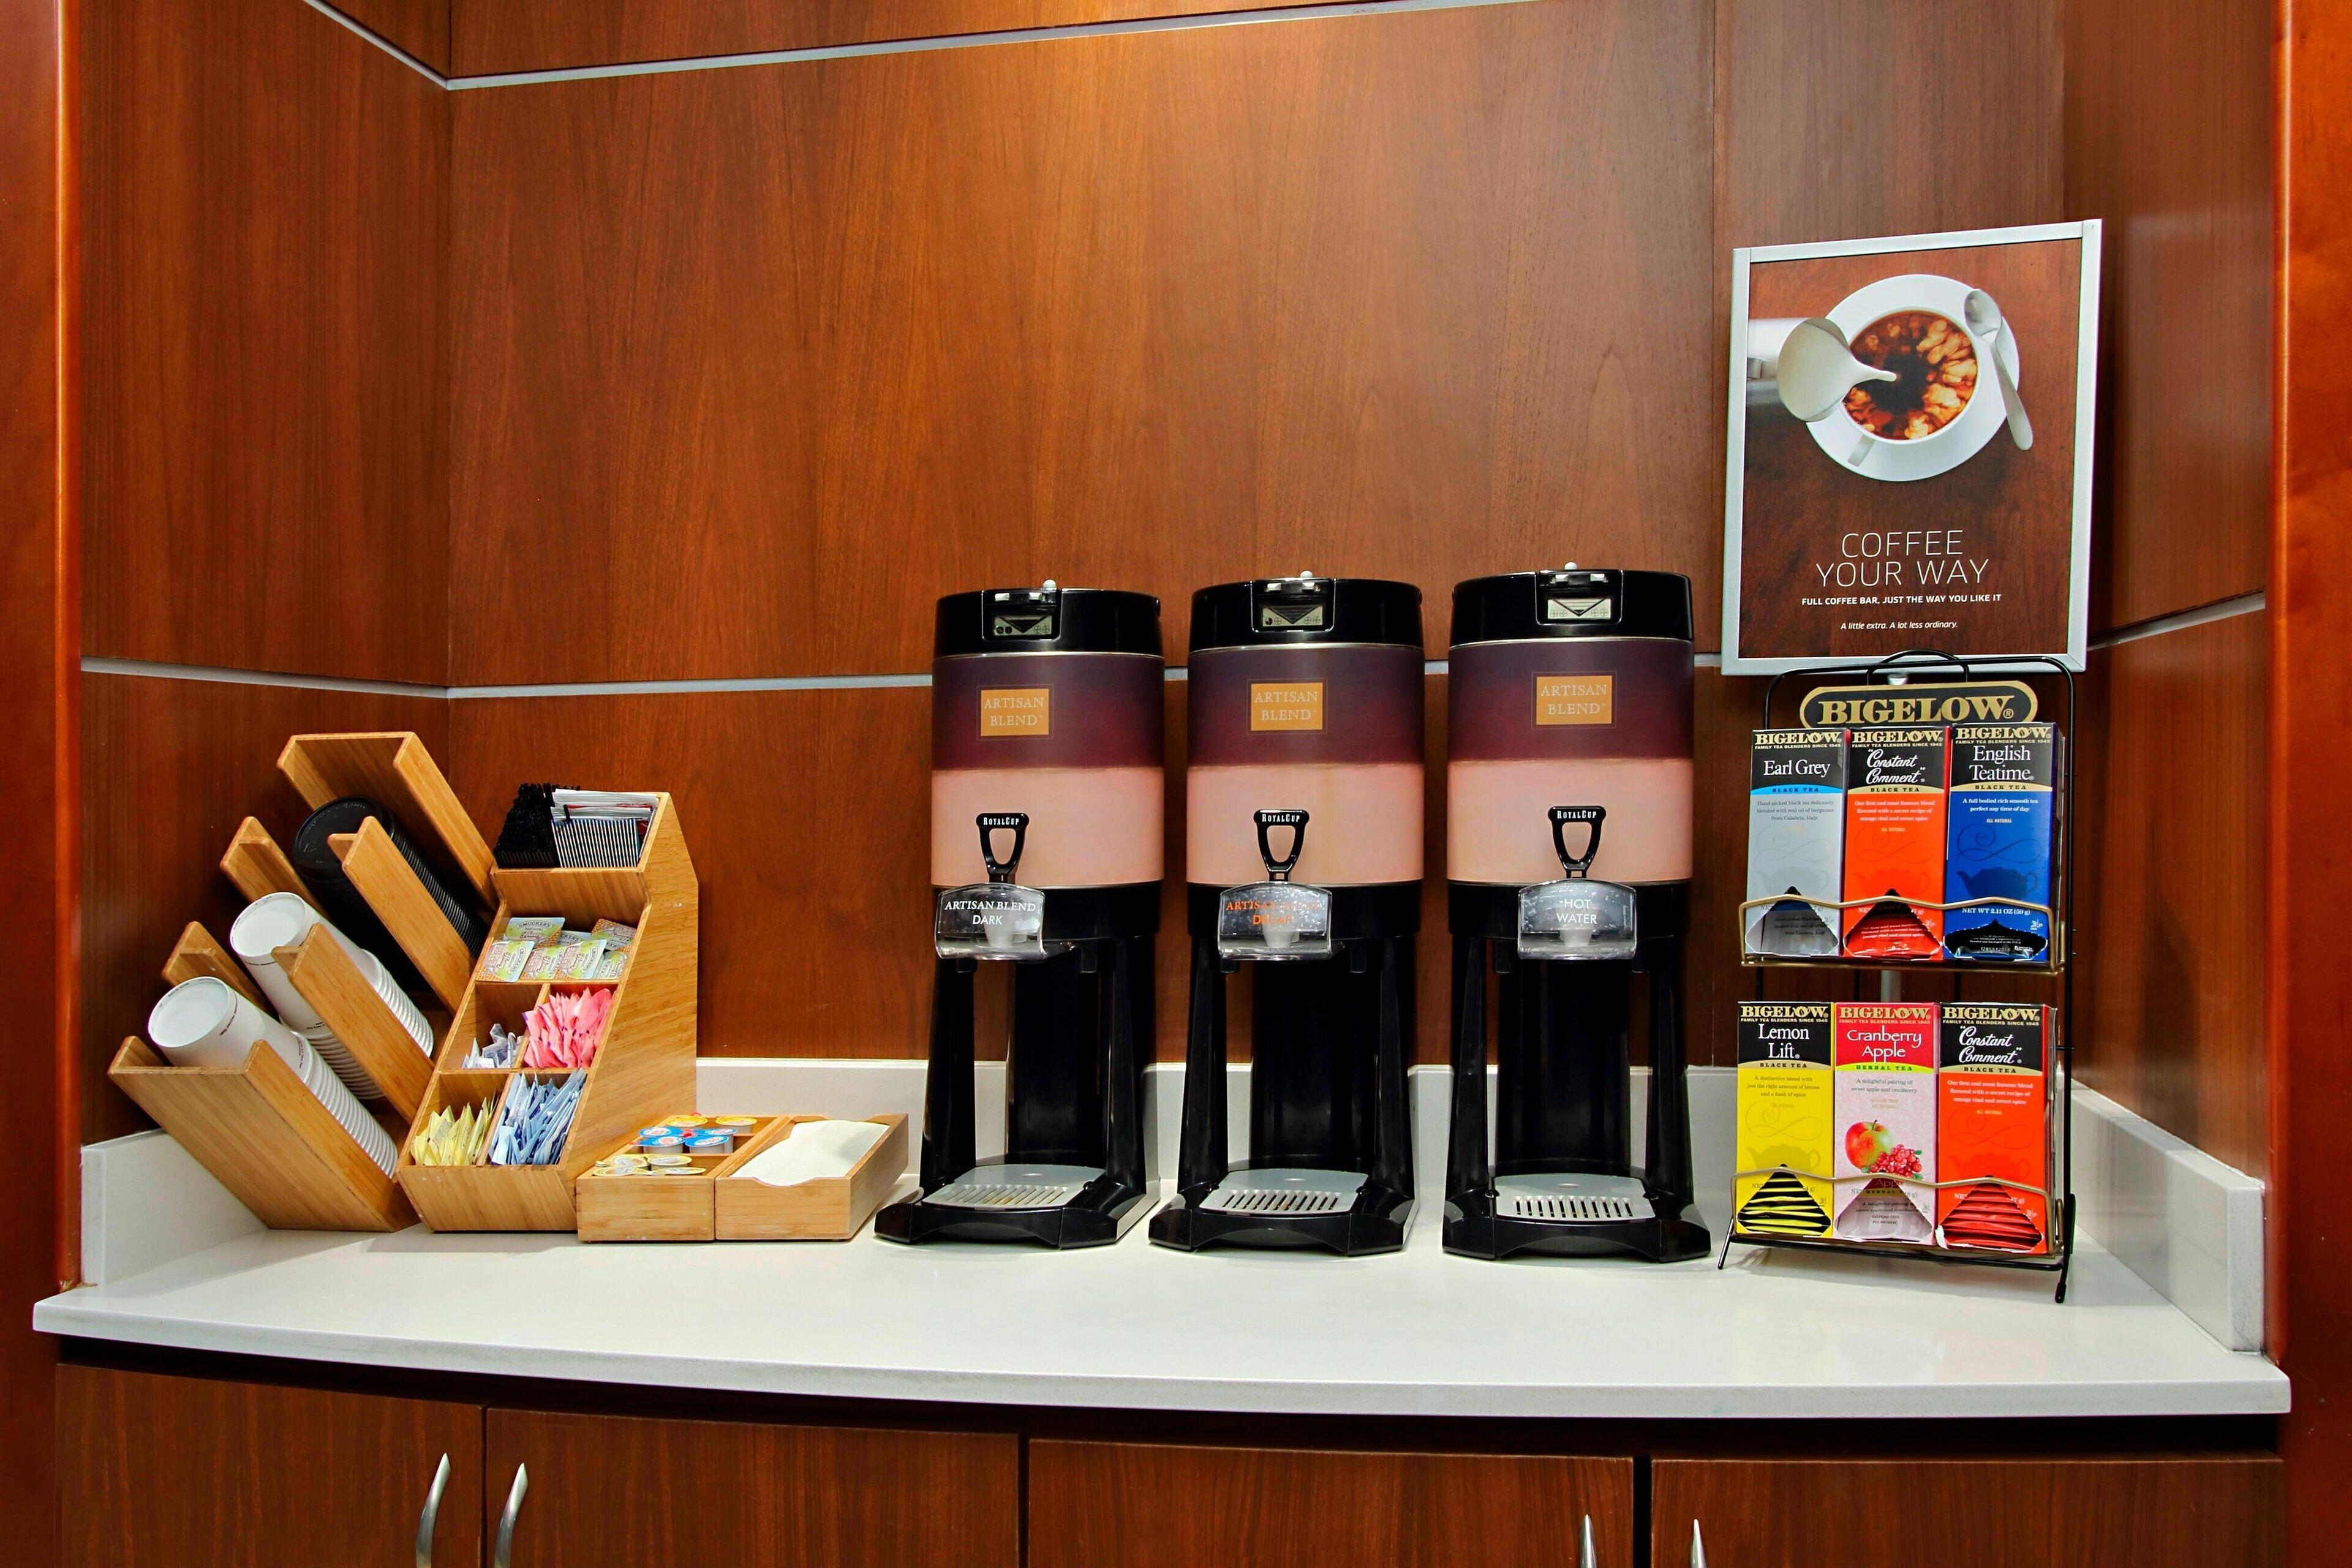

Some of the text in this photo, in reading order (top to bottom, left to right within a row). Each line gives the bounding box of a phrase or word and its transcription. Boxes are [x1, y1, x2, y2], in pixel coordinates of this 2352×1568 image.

[1842, 530, 1963, 558] COFFEE
[1816, 559, 1989, 587] YOUR WAY
[1924, 620, 1958, 630] ordinary.
[1540, 685, 1607, 696] ARTISAN
[984, 697, 1044, 709] ARTISAN
[1254, 691, 1318, 703] ARTISAN
[1261, 709, 1311, 720] BLEND
[1548, 703, 1600, 715] BLEND
[1817, 695, 2015, 725] BIGELOW
[990, 715, 1037, 726] BLEND
[1755, 732, 1842, 745] BIGELOW
[1852, 730, 1943, 743] BIGELOW
[1956, 727, 2051, 739] BIGELOW
[1972, 745, 2031, 764] English
[1763, 759, 1831, 778] Earl Grey
[1969, 764, 2031, 780] Teatime
[944, 900, 1036, 911] ARTISAN BLEND
[1226, 900, 1276, 911] ARTISAN
[1564, 899, 1591, 909] HOT
[973, 914, 1003, 925] DARK
[1556, 913, 1597, 924] WATER
[1741, 1006, 1828, 1017] BIGELOW
[1839, 1007, 1931, 1019] BIGELOW
[1943, 1007, 2040, 1020] BIGELOW
[1758, 1023, 1809, 1039] Lemon
[1847, 1025, 1921, 1049] Cranberry
[1768, 1042, 1795, 1058] Lift
[1862, 1041, 1906, 1063] Apple
